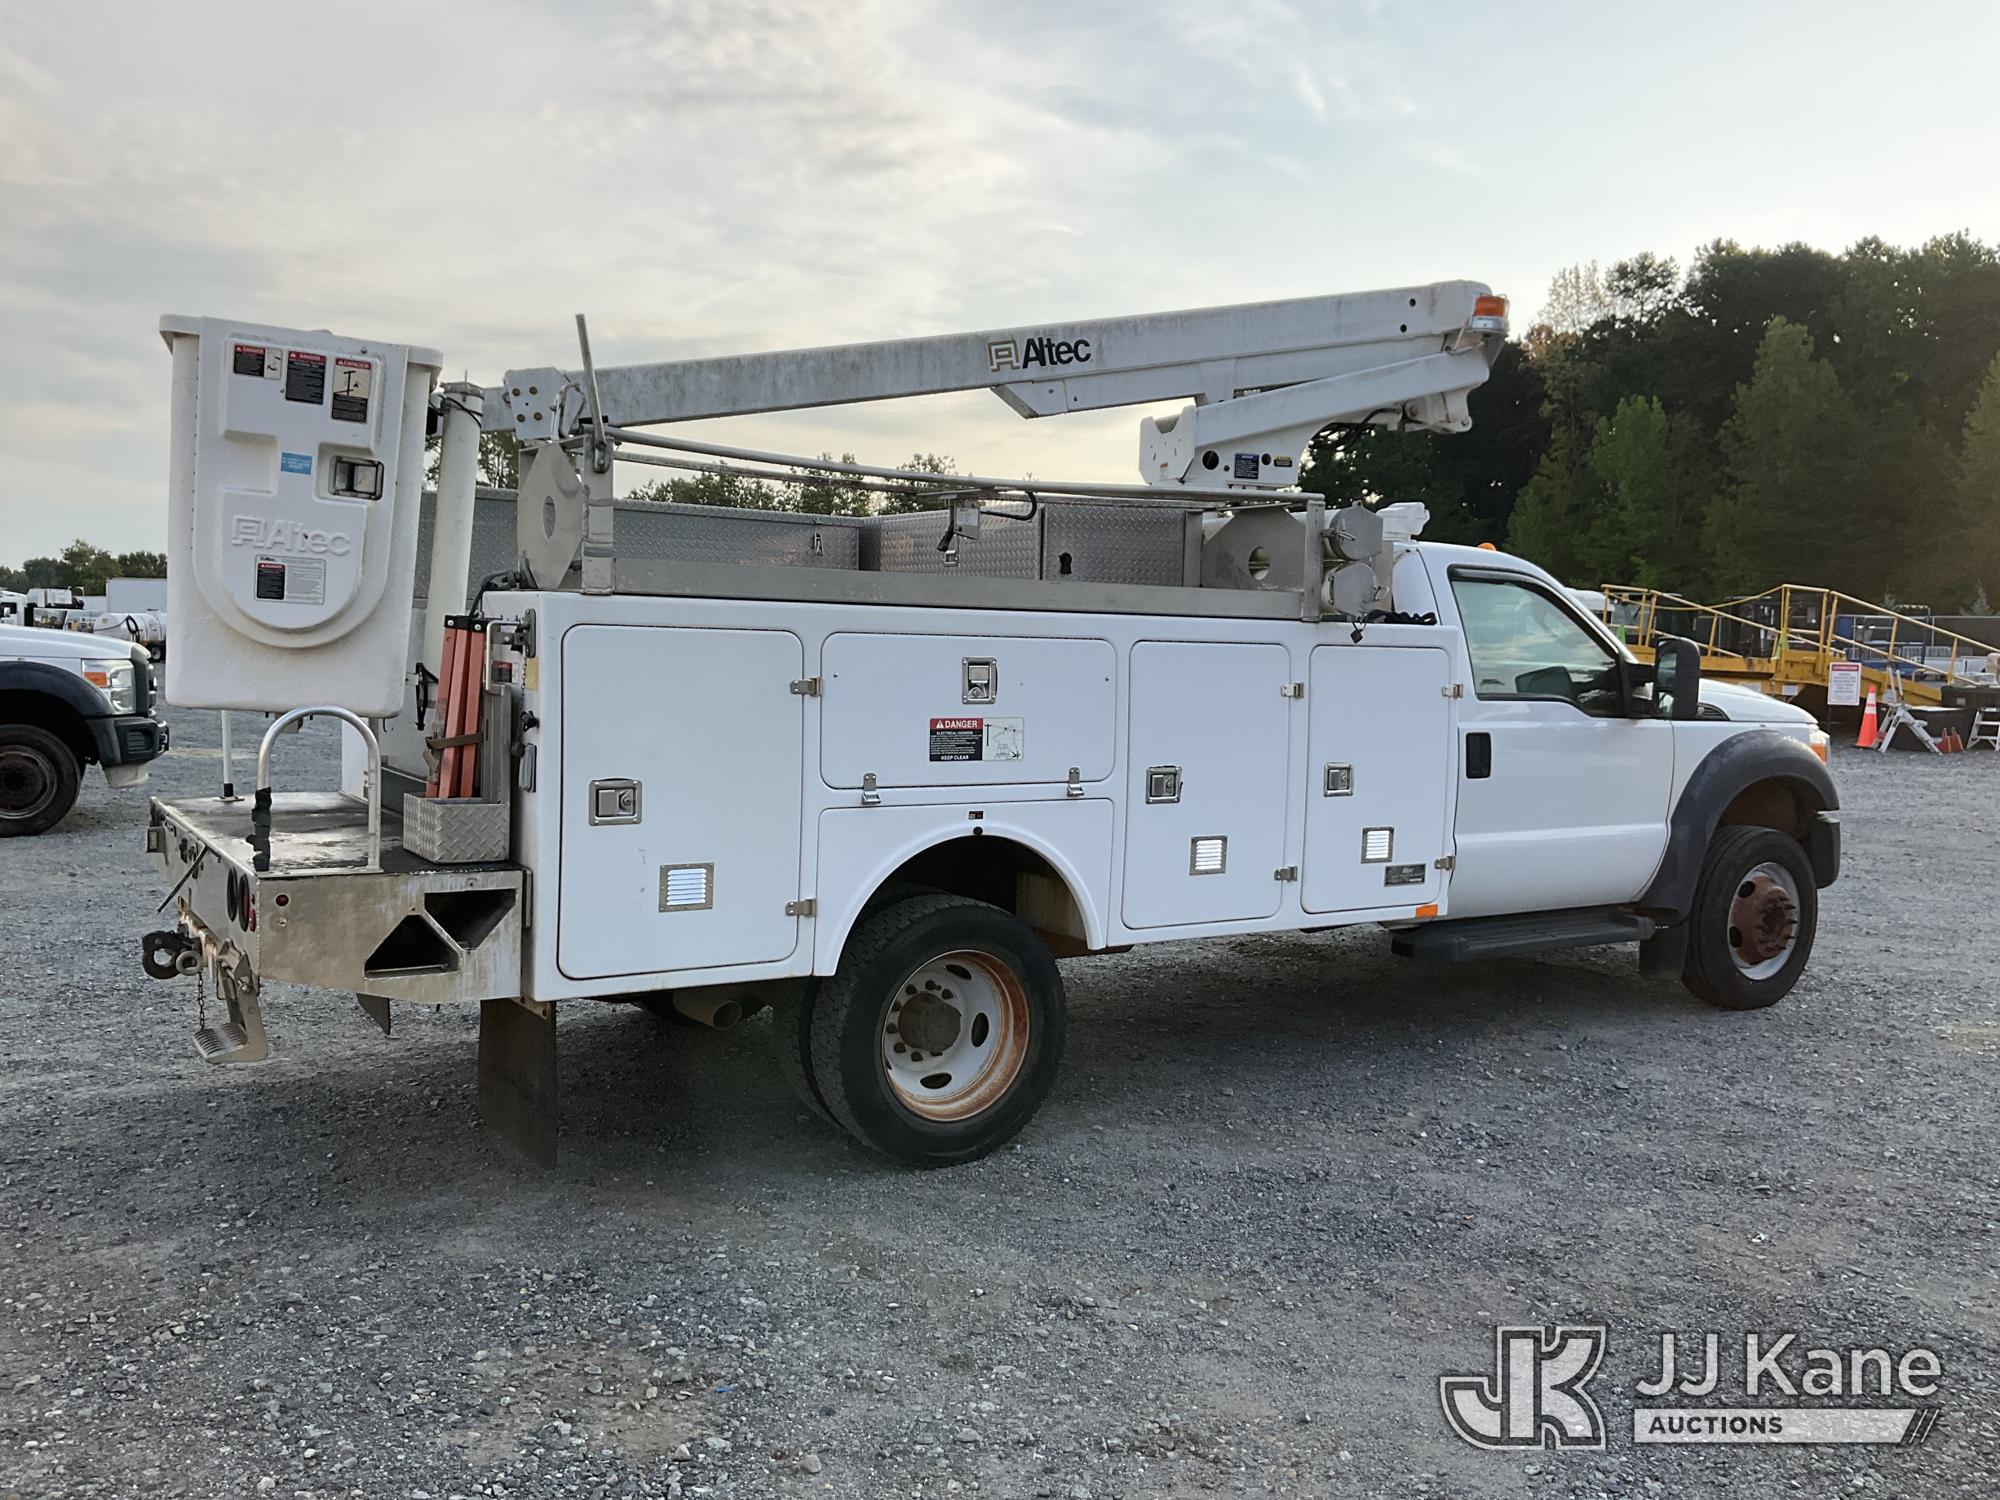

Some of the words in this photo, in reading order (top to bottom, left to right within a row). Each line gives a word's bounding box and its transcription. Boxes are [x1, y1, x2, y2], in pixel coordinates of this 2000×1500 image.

[299, 353, 321, 361] DANGER
[1022, 336, 1092, 369] Altec
[343, 360, 370, 368] DANGER
[265, 519, 351, 557] Altec
[944, 720, 978, 729] DANGER
